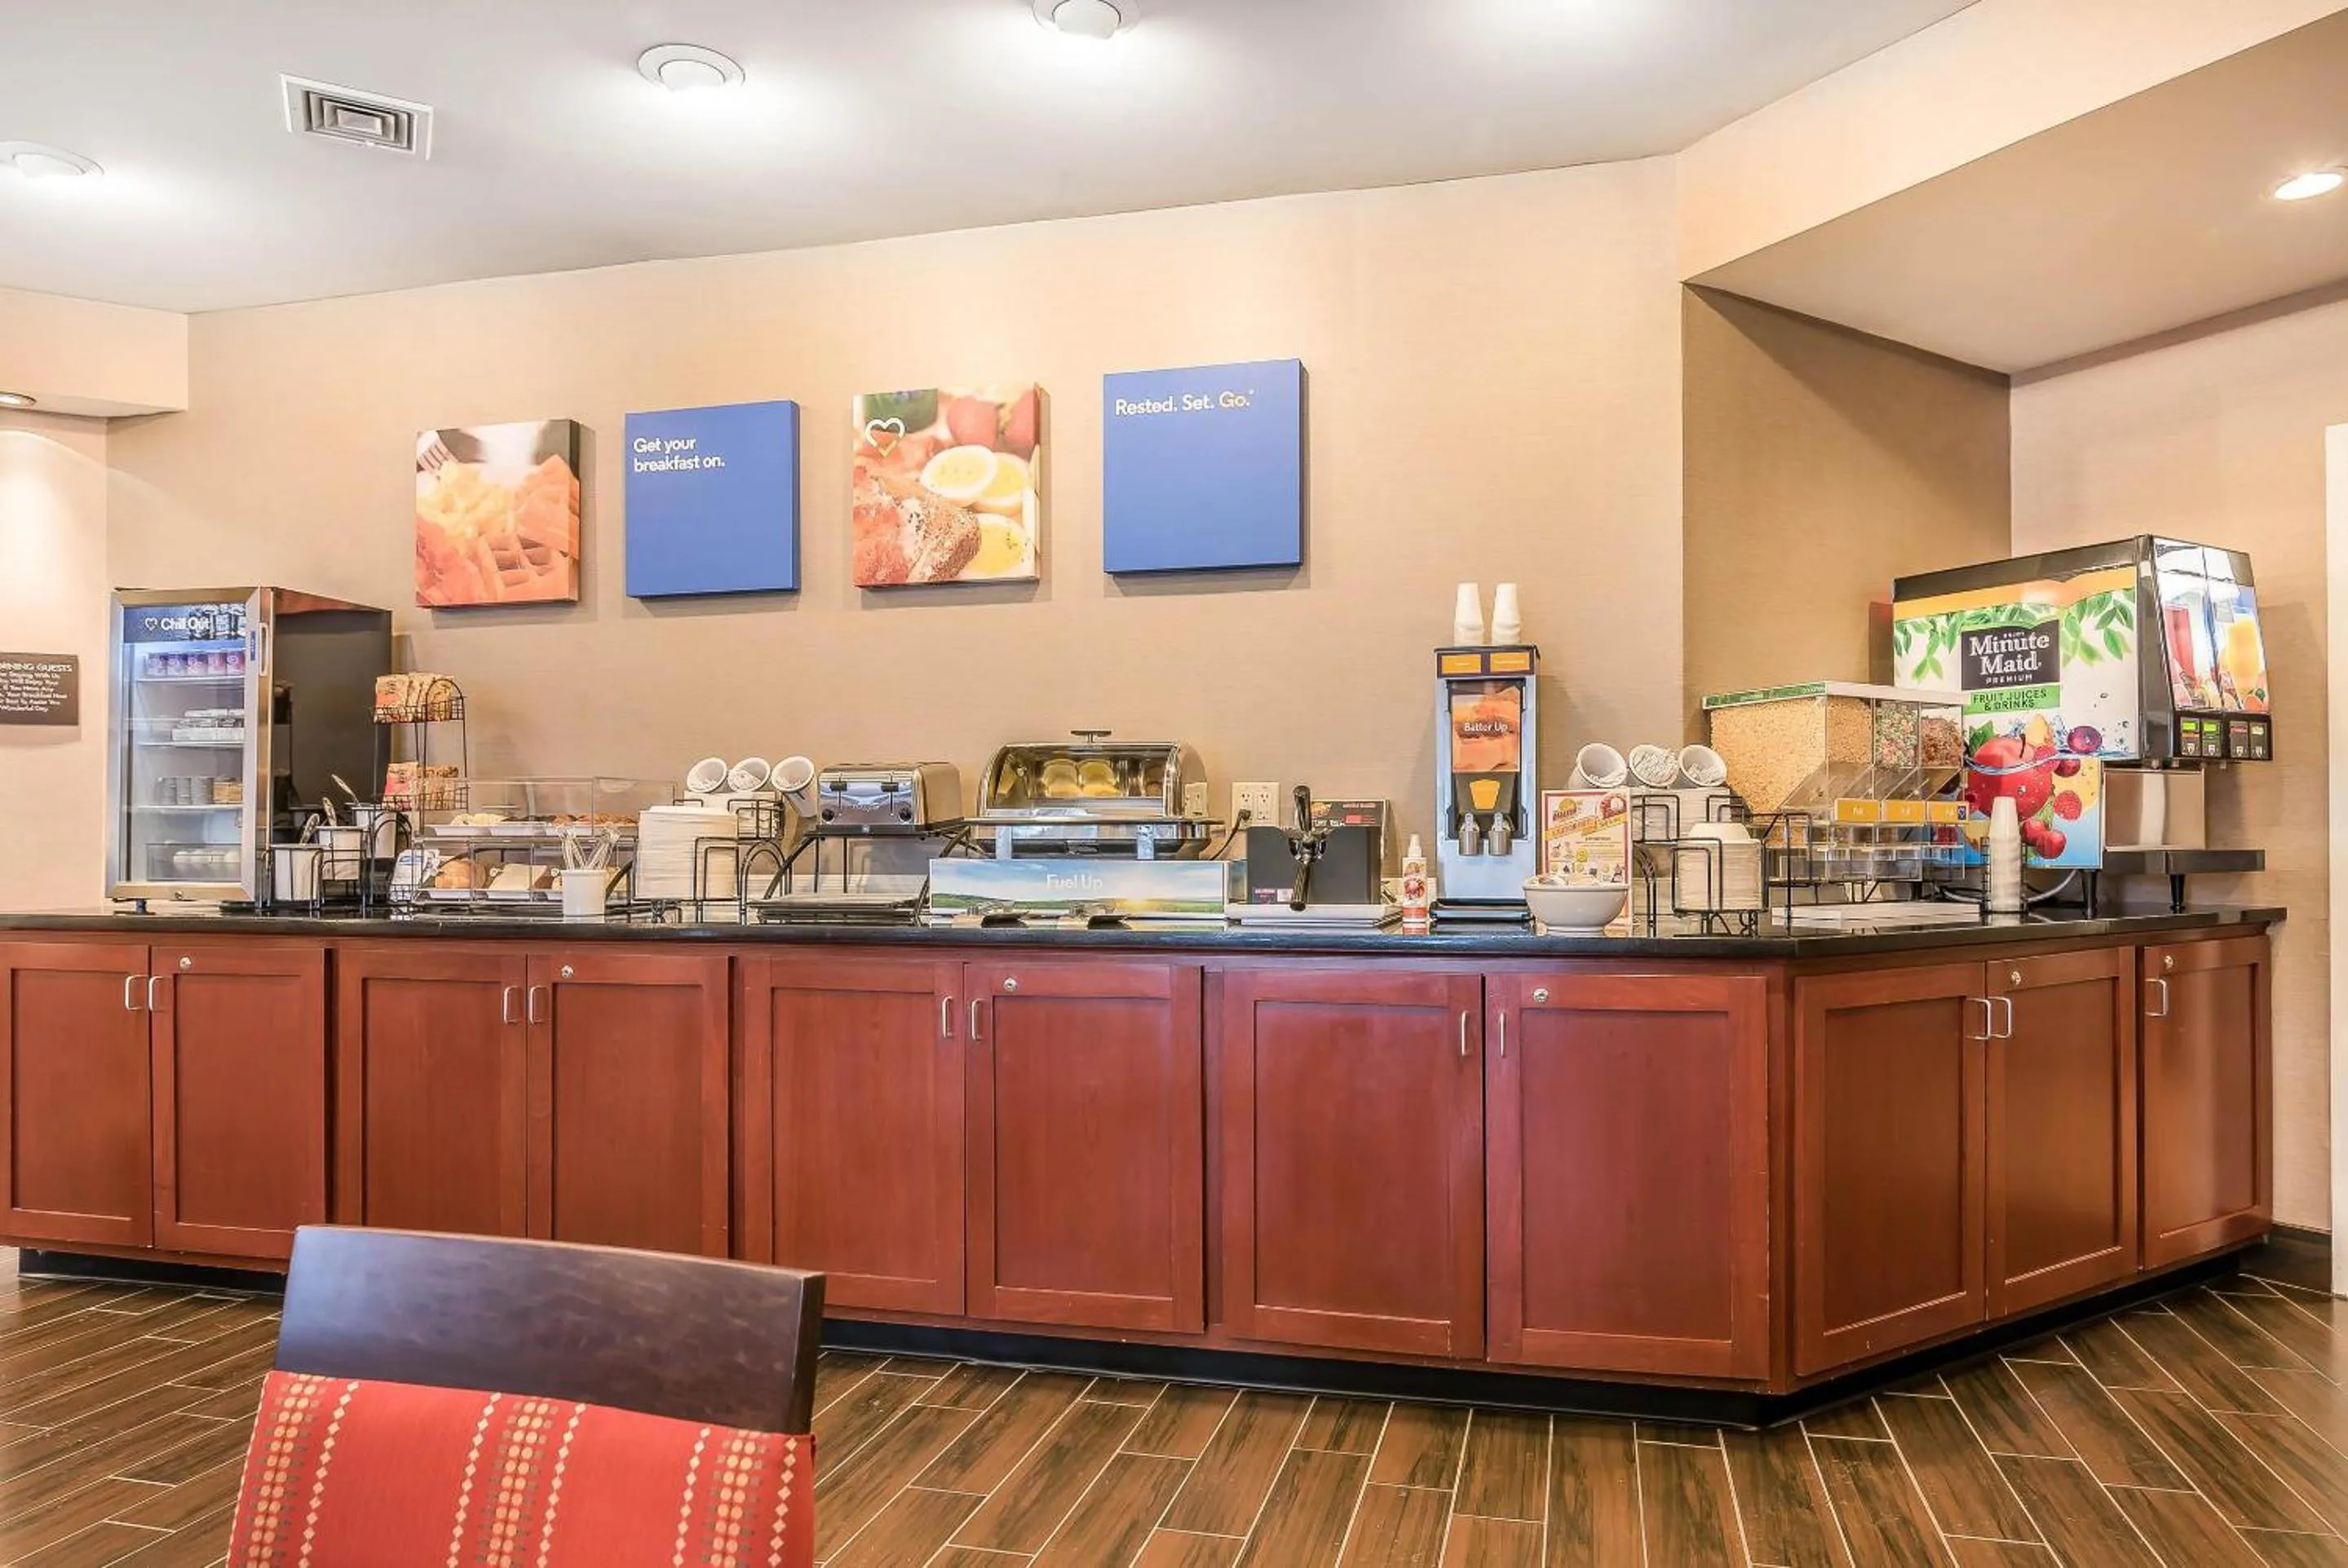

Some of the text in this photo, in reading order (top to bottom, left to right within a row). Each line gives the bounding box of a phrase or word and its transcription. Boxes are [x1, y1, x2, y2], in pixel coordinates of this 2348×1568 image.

[1115, 395, 1178, 416] Rested.
[1182, 394, 1214, 410] Set.
[633, 437, 696, 454] Get your
[634, 454, 726, 472] breakfast on.
[161, 617, 186, 630] Chill
[1969, 631, 2050, 657] Minute
[36, 662, 73, 672] GUESTS
[1979, 651, 2039, 676] Maid
[1985, 673, 2033, 685] PREMIUM
[1974, 688, 2047, 704] FRUIT JUICES
[1984, 699, 2035, 712] & DRINKS
[1464, 721, 1508, 733] Batter Up
[1046, 873, 1103, 894] Fuel Up
